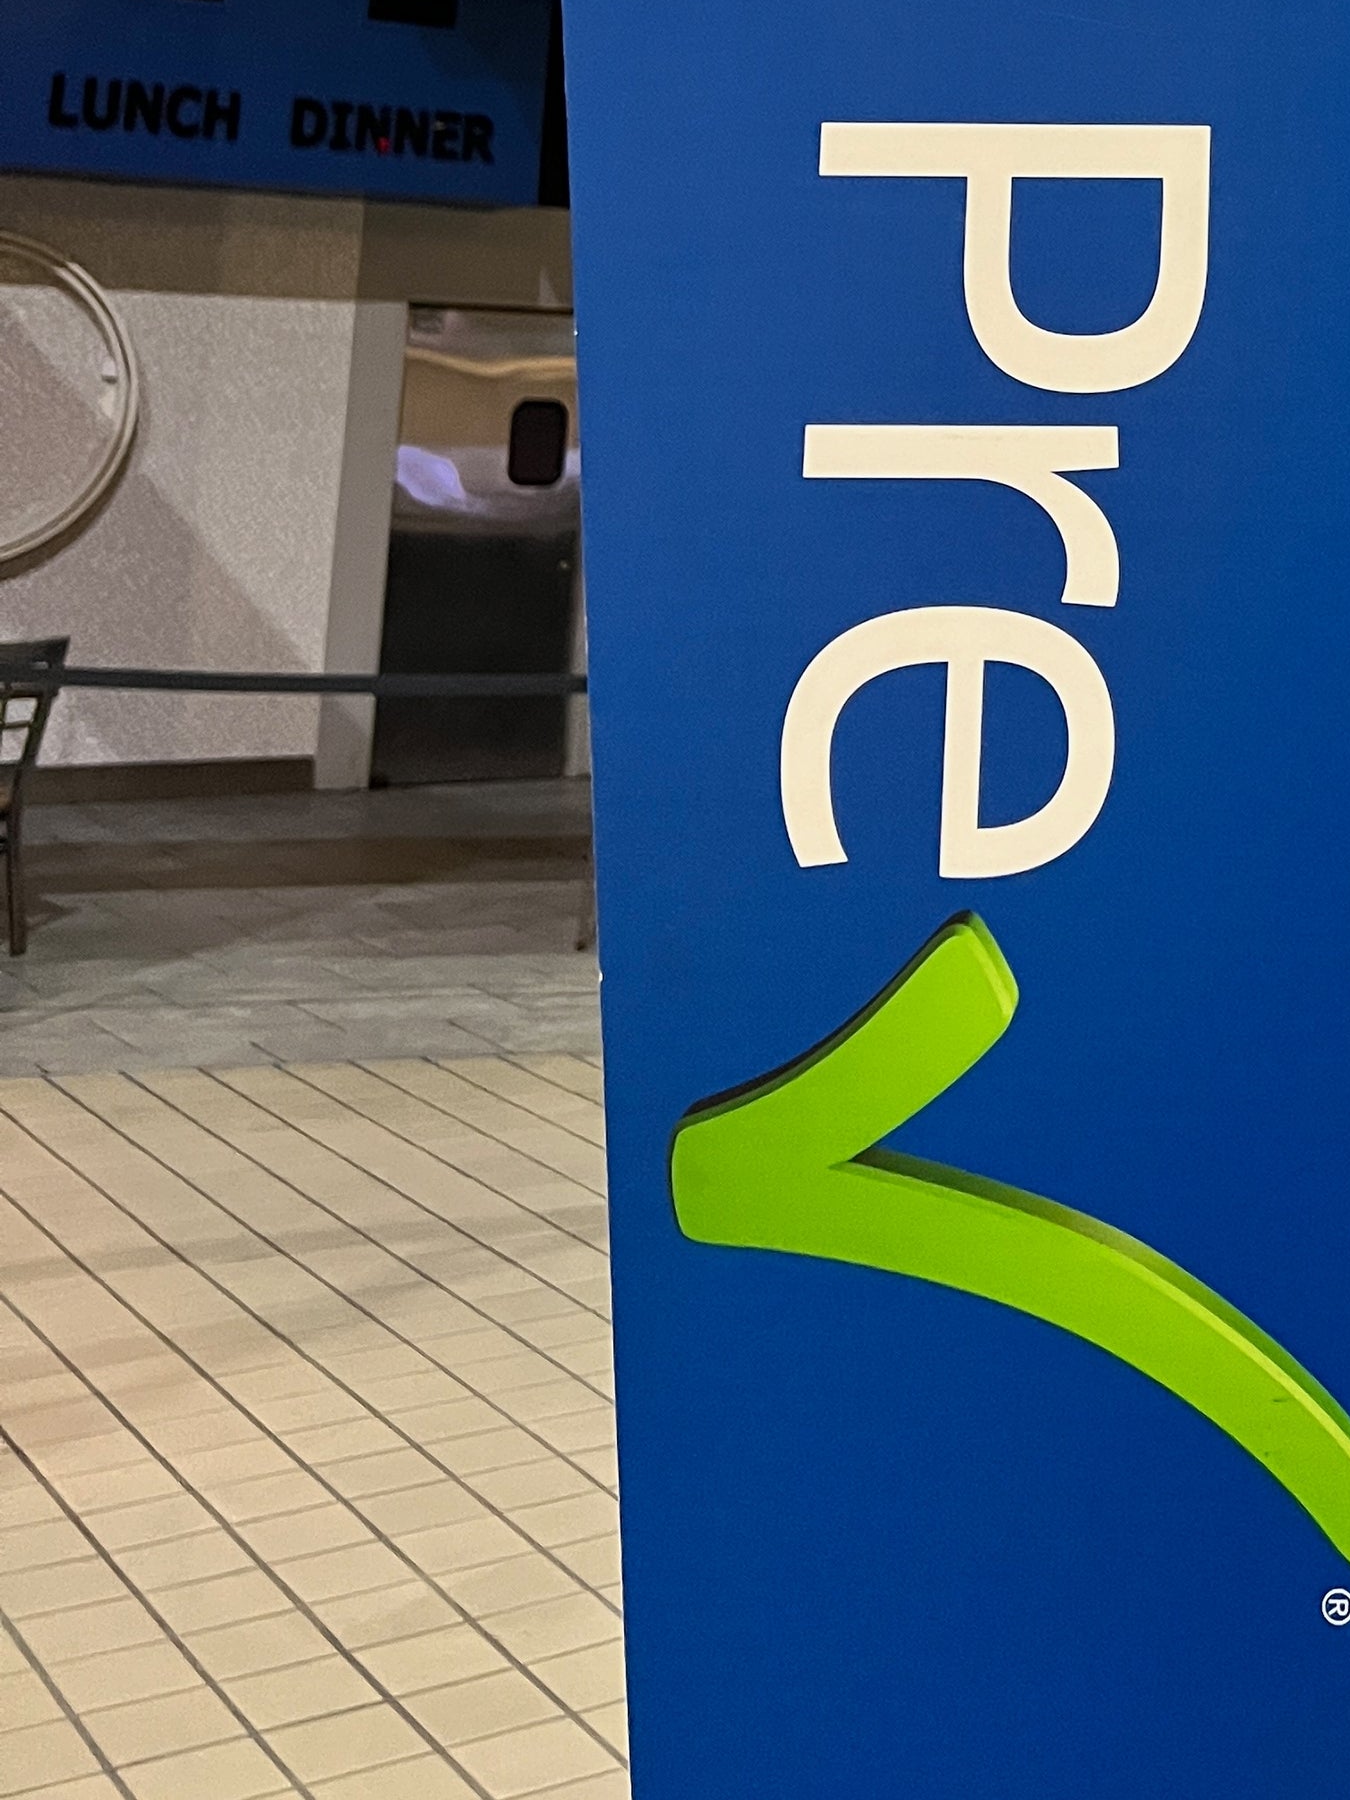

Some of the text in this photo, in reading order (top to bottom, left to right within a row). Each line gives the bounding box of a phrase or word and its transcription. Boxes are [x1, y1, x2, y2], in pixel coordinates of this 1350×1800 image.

[48, 71, 496, 163] LUNCH DINNER
[781, 120, 1212, 880] Pre
